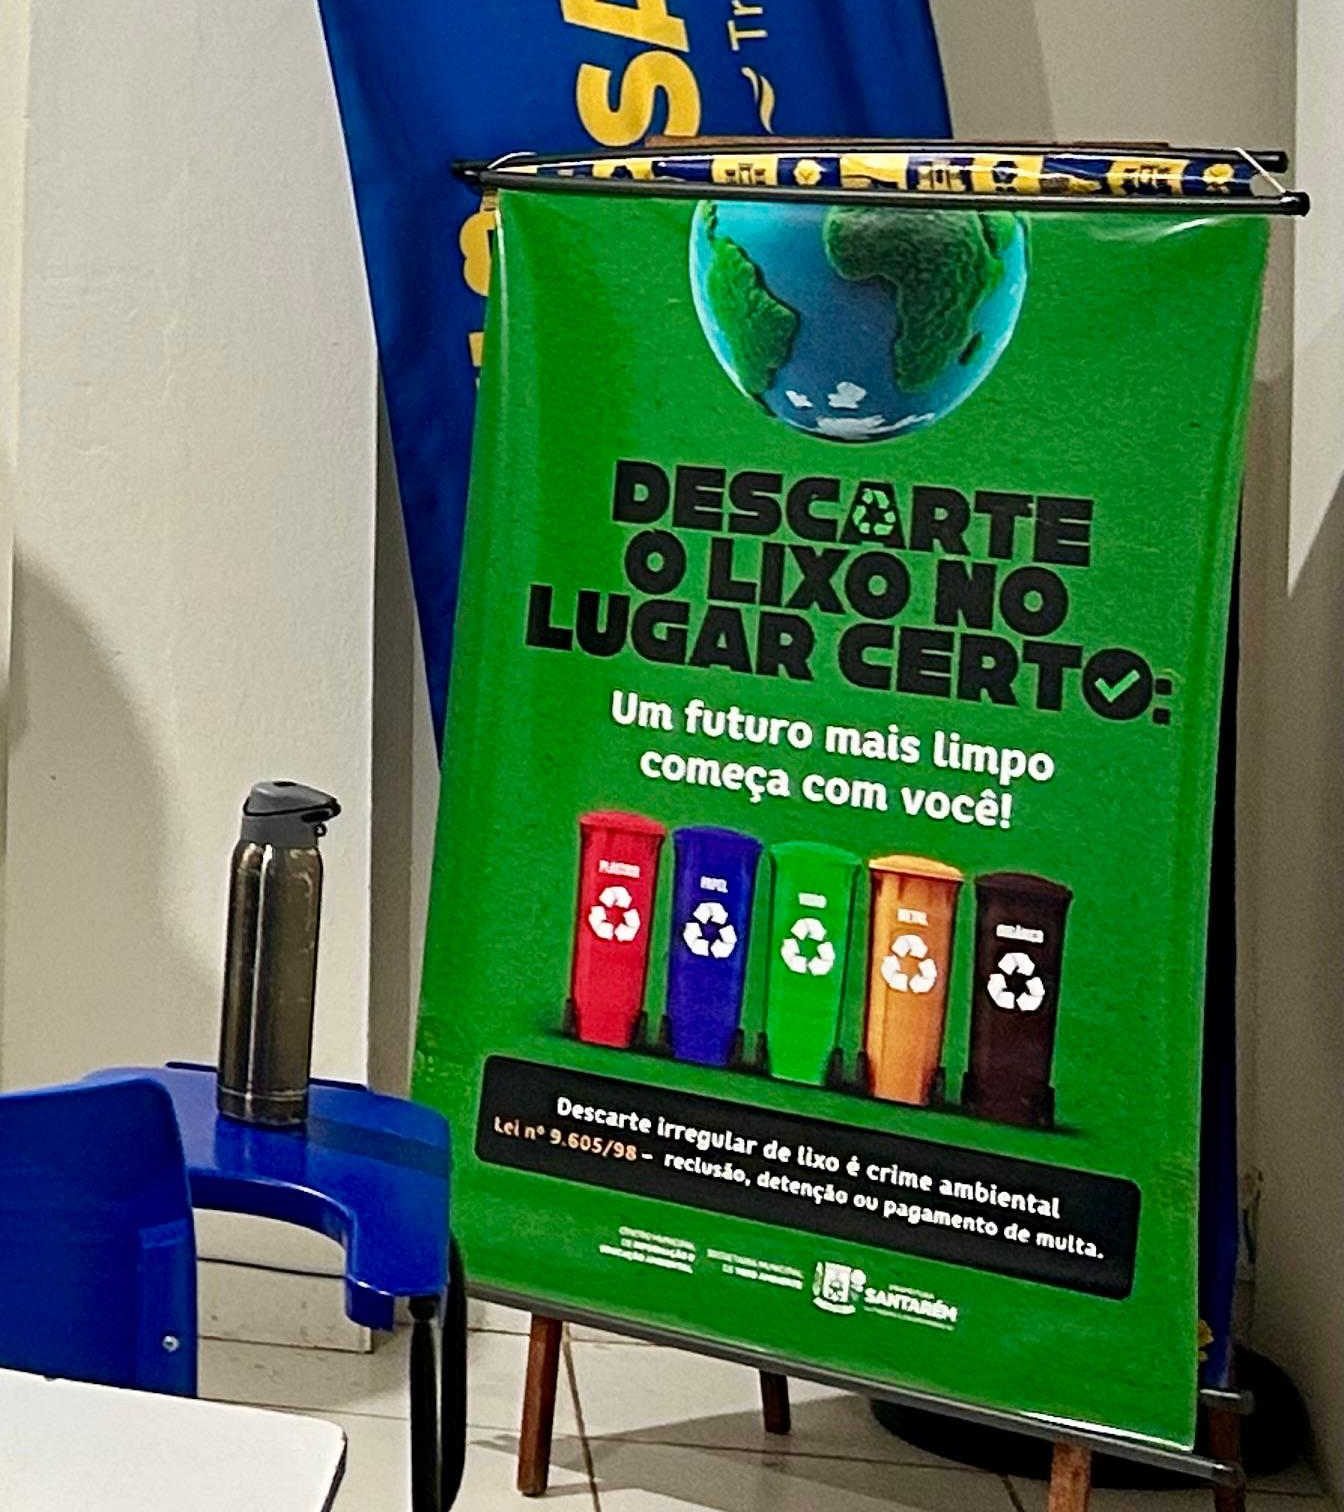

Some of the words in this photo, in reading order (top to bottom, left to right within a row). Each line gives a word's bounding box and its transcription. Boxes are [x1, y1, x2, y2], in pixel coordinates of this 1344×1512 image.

[612, 459, 1095, 568] DESCARTE
[525, 584, 816, 682] LUGAR
[623, 529, 687, 596] O
[707, 536, 912, 621] LIXO
[934, 559, 1070, 637] NO
[612, 690, 674, 731] Um
[684, 698, 814, 749] futuro
[825, 724, 922, 764] mais
[933, 730, 1056, 784] limpo
[640, 751, 792, 802] começa
[802, 774, 889, 812] com
[901, 777, 1014, 830] você!
[493, 1115, 520, 1137] Lei
[549, 1128, 638, 1162] 9.605/98
[663, 1153, 751, 1187] reclusão,
[756, 1170, 849, 1205] detenção
[853, 1193, 879, 1211] ou
[883, 1200, 999, 1236] pagamento
[1003, 1222, 1031, 1244] de
[1035, 1232, 1105, 1259] multa.
[557, 1096, 652, 1134] Descarte
[656, 1116, 759, 1155] irregular
[762, 1139, 792, 1163] de
[797, 1144, 840, 1172] lixo
[845, 1155, 861, 1177] é
[866, 1164, 933, 1192] crime
[938, 1179, 1061, 1220] ambiental
[863, 1287, 959, 1323] SANTARÉM
